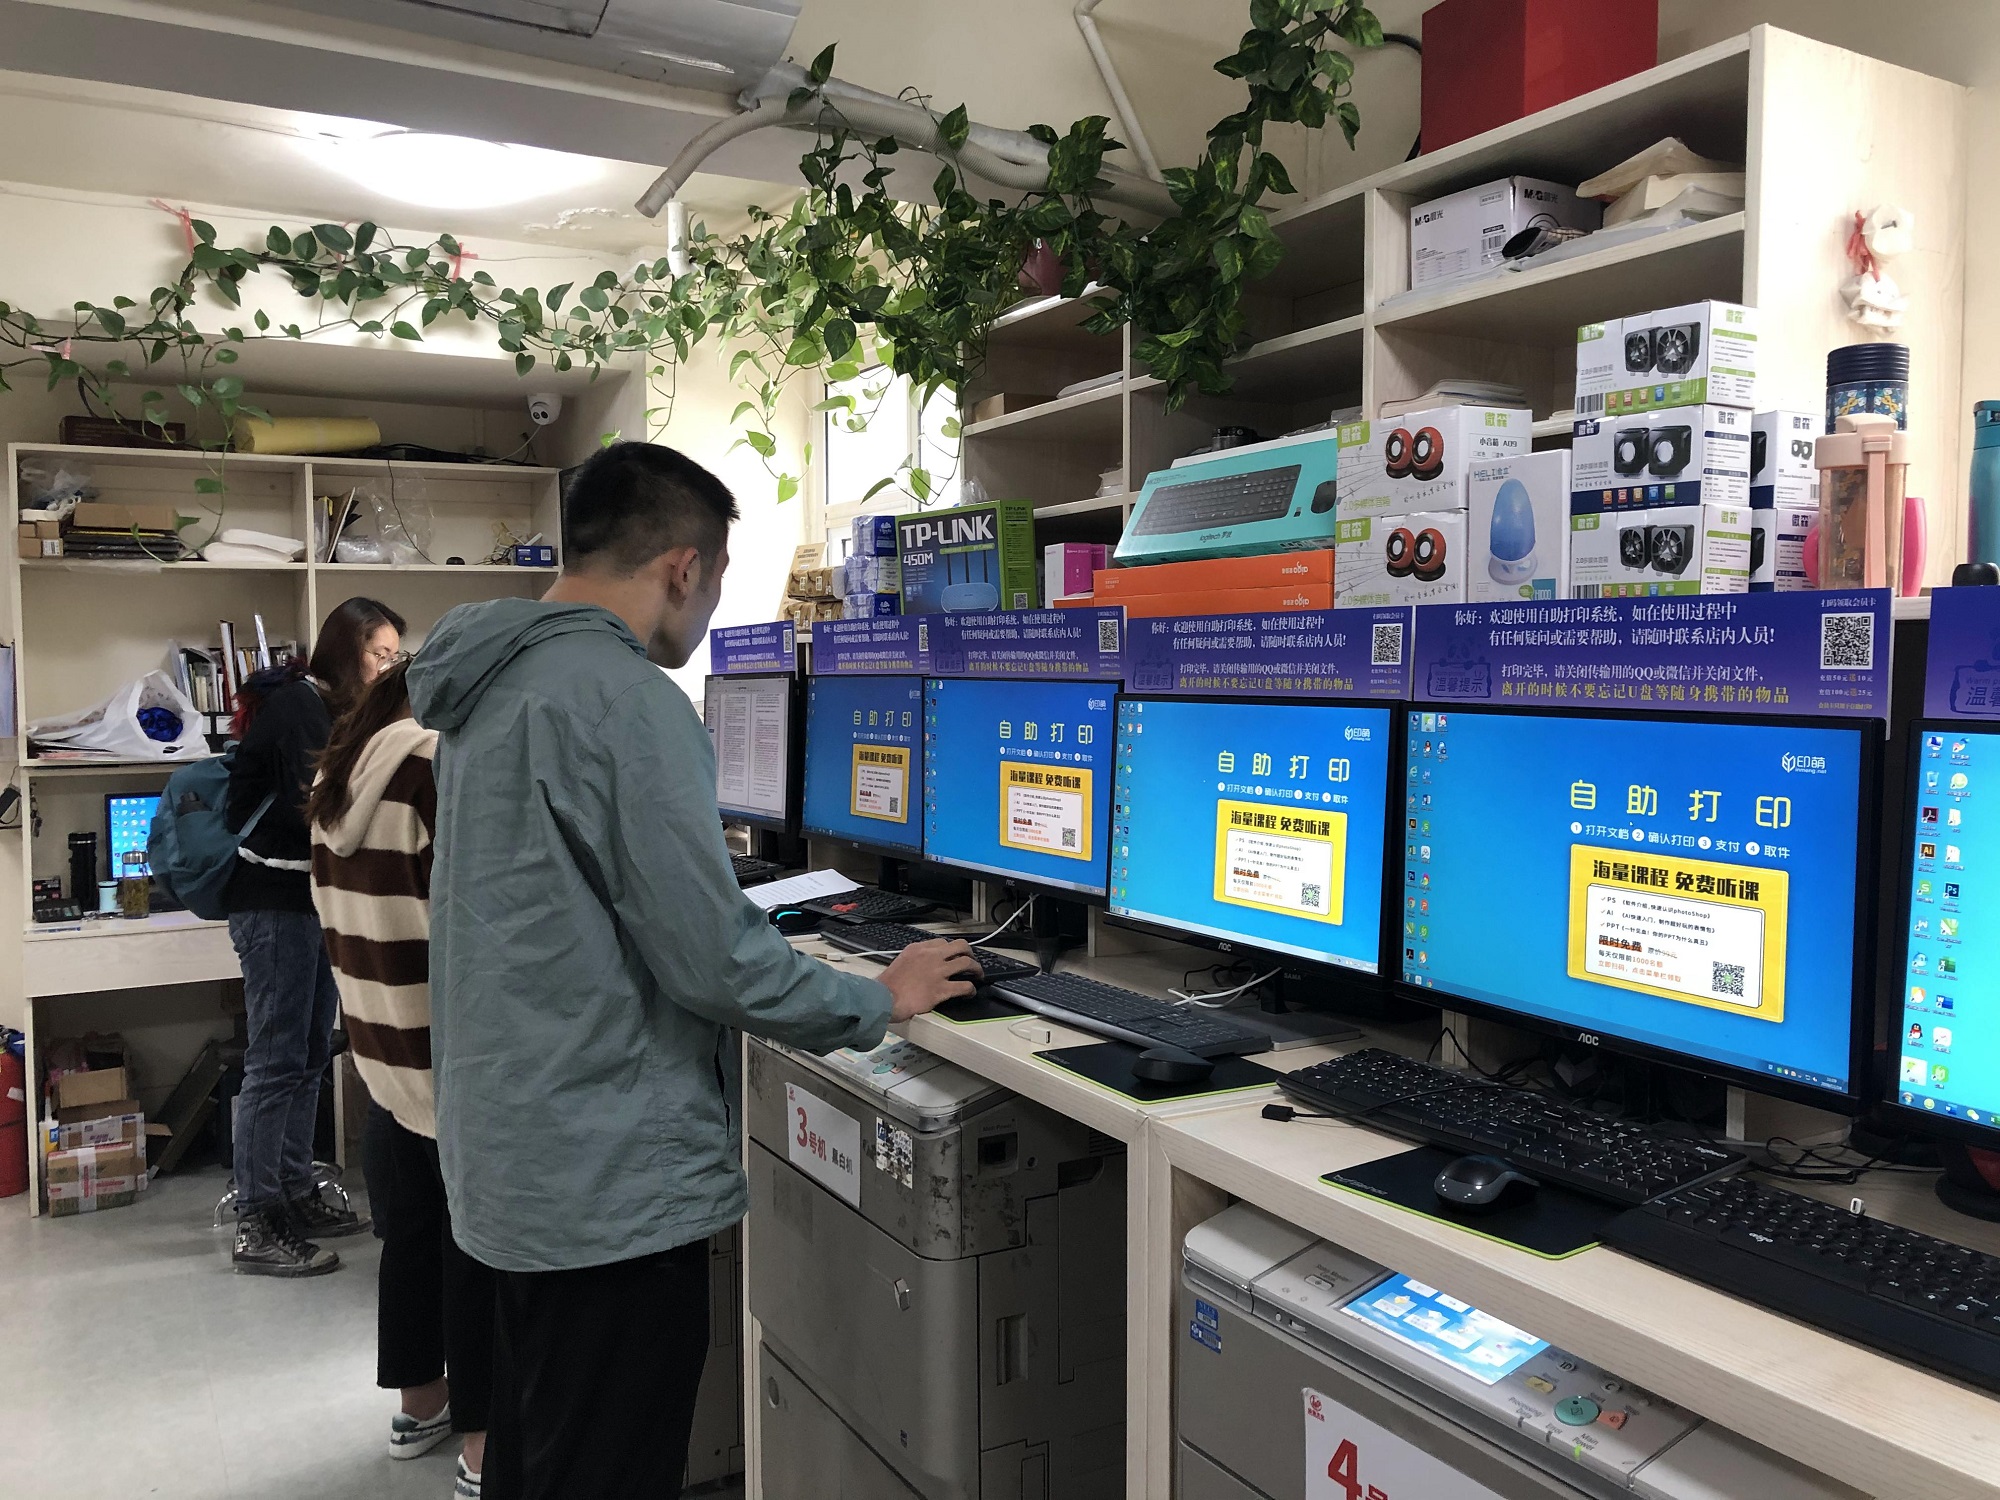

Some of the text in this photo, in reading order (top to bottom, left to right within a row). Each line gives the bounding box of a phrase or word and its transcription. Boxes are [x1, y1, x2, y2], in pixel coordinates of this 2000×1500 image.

[901, 514, 995, 549] TP-LINK
[903, 552, 934, 566] 450M
[1455, 601, 1737, 626] 你好：欢迎使用自助打印系统，如在使用过程中
[1435, 676, 1483, 693] 温馨提示
[1502, 681, 1790, 704] 离开的时候不要忘记U盘等随身携带的物品
[853, 709, 912, 728] 自助打印
[999, 720, 1094, 745] 自助打印
[1218, 750, 1350, 783] 自助打印
[1797, 755, 1826, 769] 印萌
[1570, 779, 1792, 829] 自助打印
[1231, 810, 1331, 837] 海量课程 免费听课
[1585, 824, 1629, 840] 打开文档
[1648, 831, 1695, 848] 确认打印
[1715, 840, 1740, 853] 支付
[1764, 845, 1791, 859] 取件
[1924, 846, 1933, 854] Ai
[1593, 859, 1760, 902] 海量课程 免费听课
[1947, 886, 1957, 895] Ps
[1606, 922, 1620, 930] PPT
[1599, 934, 1642, 952] 限时免费
[1578, 1033, 1600, 1046] AOC
[797, 1107, 853, 1176] 3号机 黑白机
[1560, 1361, 1573, 1370] ID
[1546, 1424, 1563, 1435] Error
[1572, 1437, 1595, 1451] Power
[1581, 1433, 1599, 1445] Main
